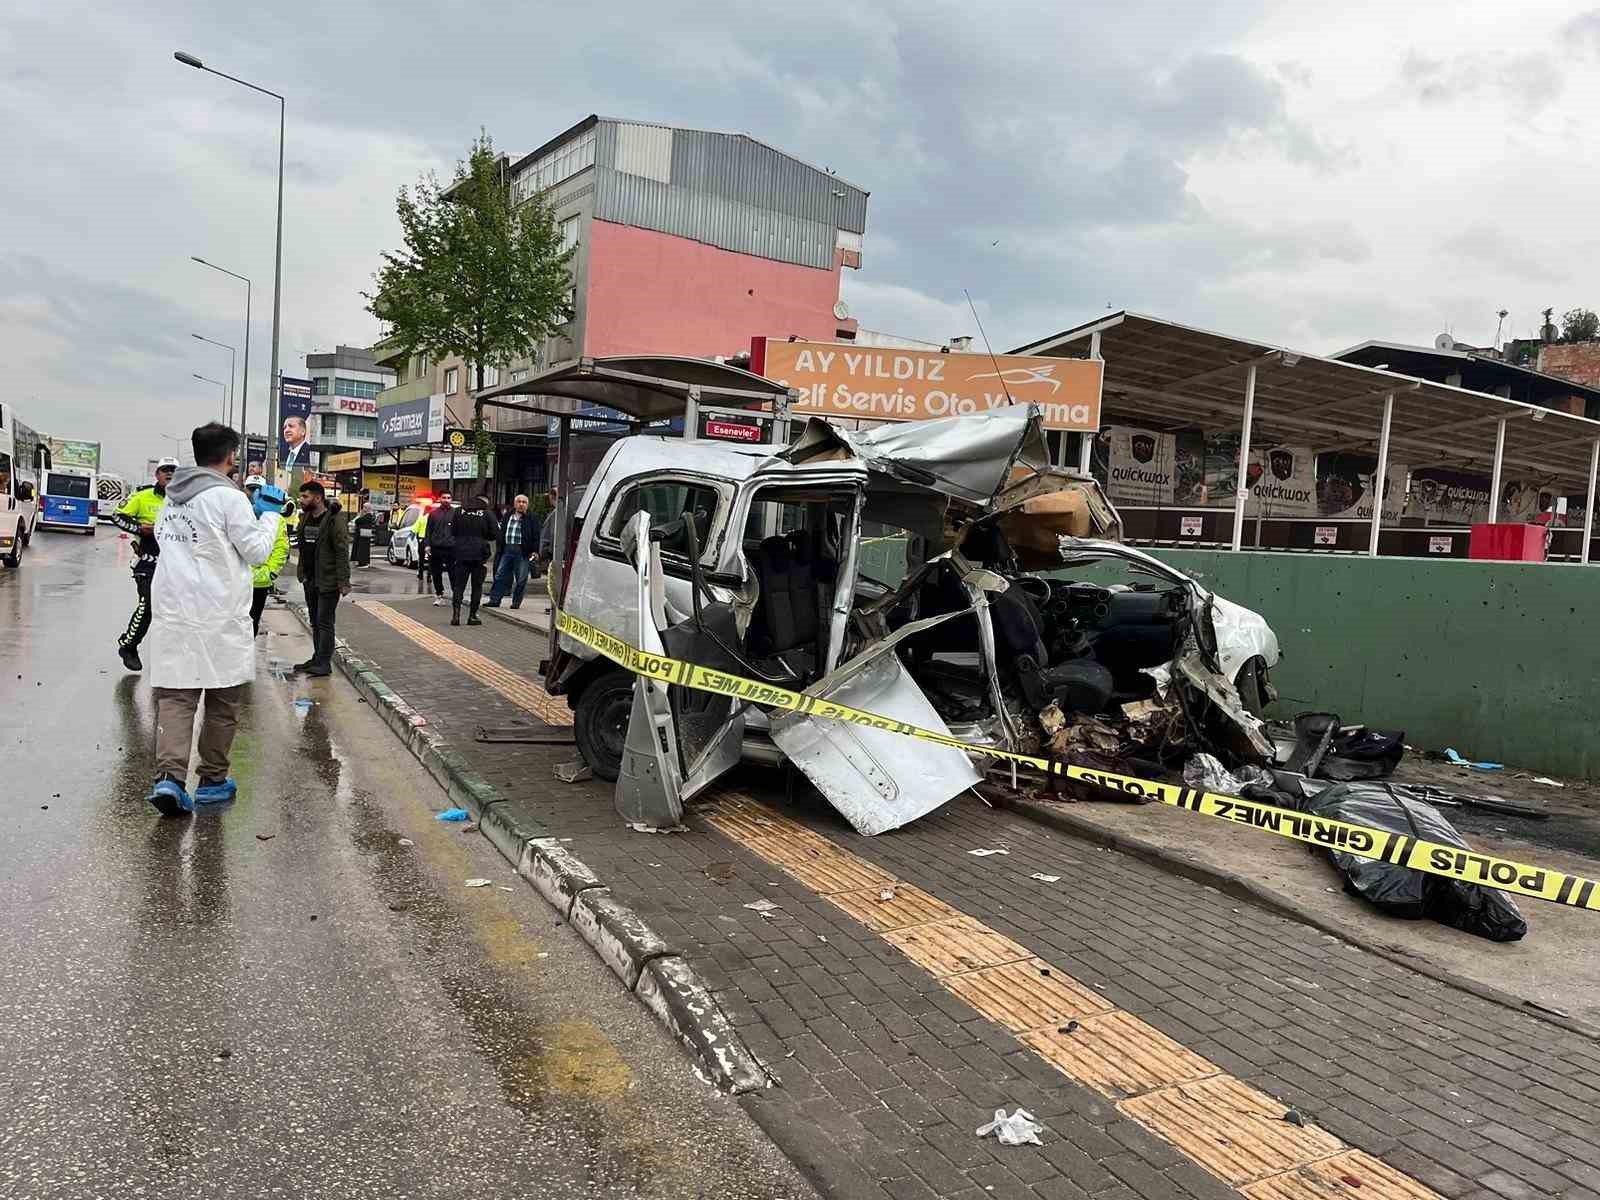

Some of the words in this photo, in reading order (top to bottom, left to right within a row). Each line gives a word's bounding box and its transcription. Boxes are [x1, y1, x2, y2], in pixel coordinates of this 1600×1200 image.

[795, 350, 836, 373] AY
[844, 352, 945, 381] YILDIZ
[777, 380, 827, 408] elf
[832, 384, 917, 414] Servis
[924, 390, 977, 416] Oto
[389, 411, 424, 432] starmaxx
[713, 425, 754, 437] Esenevler
[1111, 467, 1170, 485] quickwax
[1253, 484, 1310, 502] quickwax
[1356, 505, 1399, 521] quiwax
